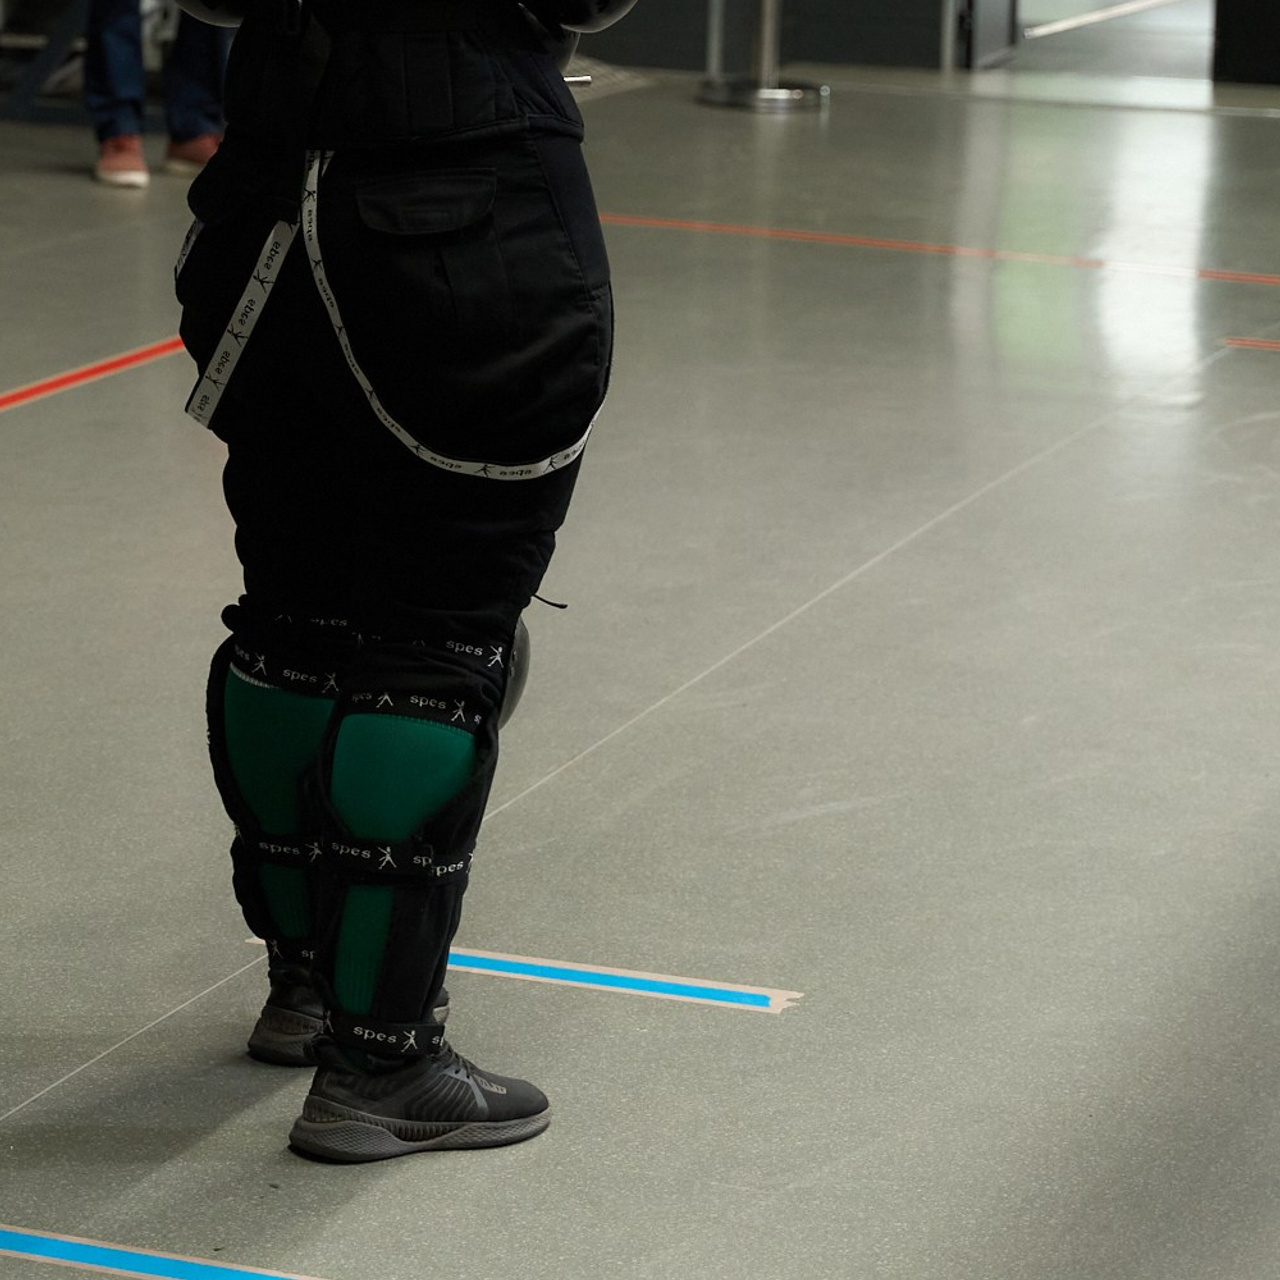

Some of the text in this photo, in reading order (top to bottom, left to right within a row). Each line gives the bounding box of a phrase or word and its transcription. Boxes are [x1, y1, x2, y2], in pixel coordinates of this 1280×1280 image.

[445, 639, 483, 657] spes
[282, 669, 318, 684] spes
[409, 694, 447, 710] spes
[258, 841, 301, 856] spes
[331, 841, 371, 859] spes
[435, 860, 464, 877] pes
[353, 1024, 397, 1044] spes
